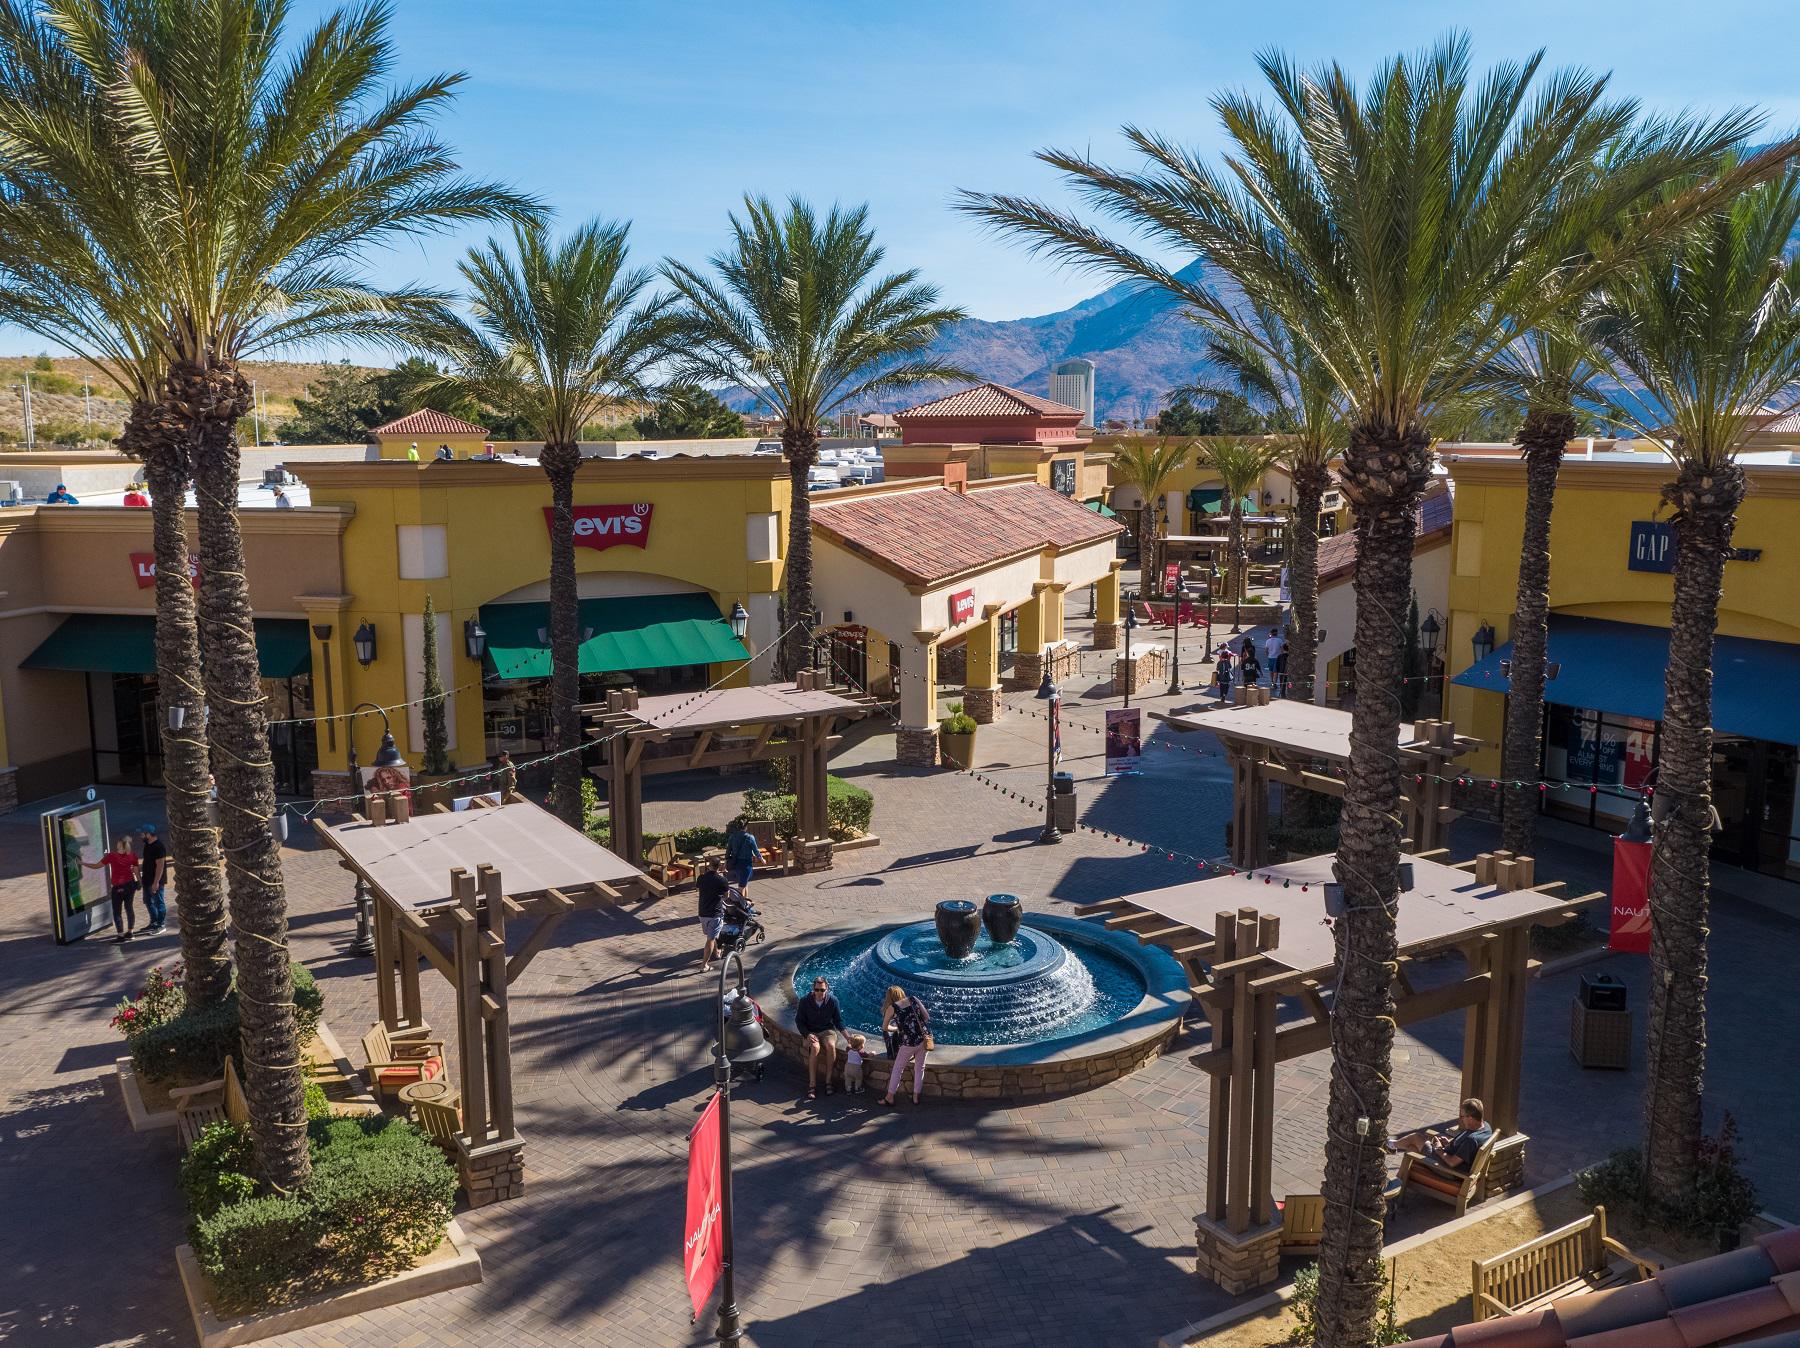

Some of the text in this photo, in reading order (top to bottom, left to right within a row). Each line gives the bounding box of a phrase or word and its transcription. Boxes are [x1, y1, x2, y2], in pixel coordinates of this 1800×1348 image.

[571, 515, 642, 535] evi's
[1636, 533, 1669, 561] GAP
[1614, 906, 1651, 917] NAUT
[685, 1202, 721, 1255] NAUTICA
